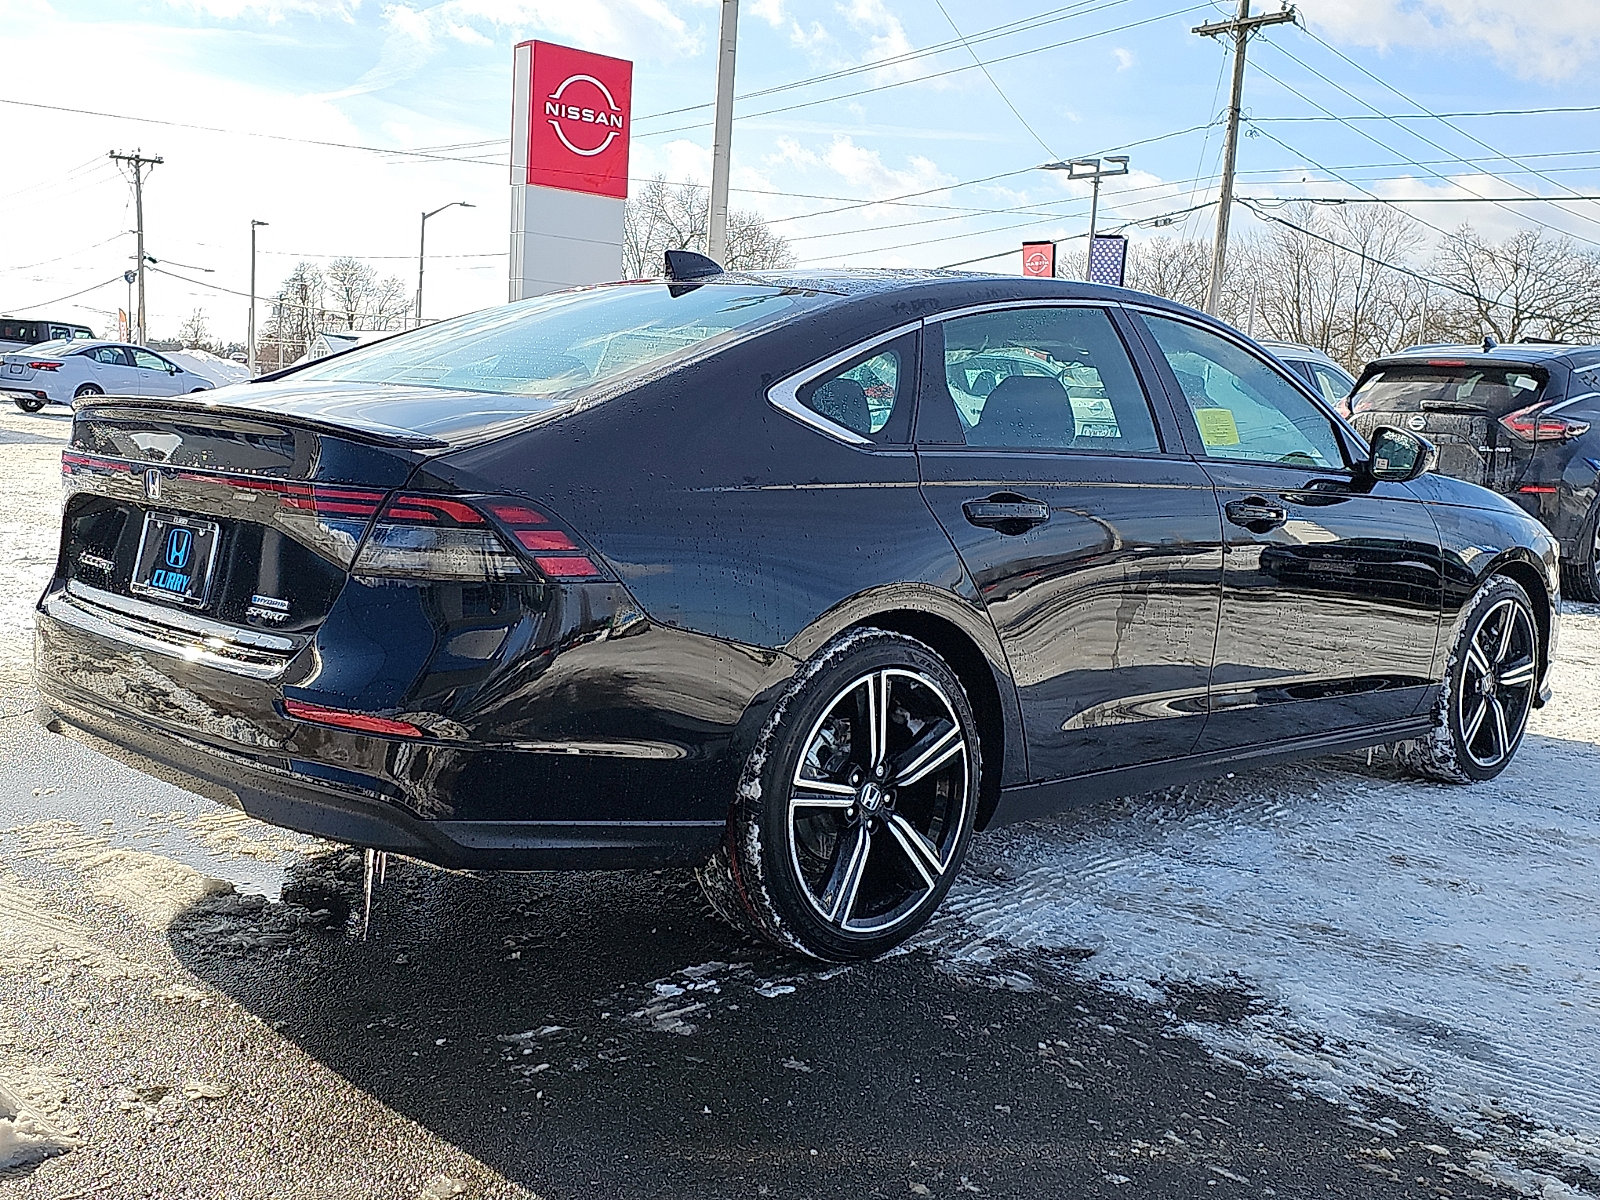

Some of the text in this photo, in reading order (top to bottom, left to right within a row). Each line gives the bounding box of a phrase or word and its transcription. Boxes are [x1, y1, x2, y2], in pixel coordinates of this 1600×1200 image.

[545, 101, 623, 128] NISSAN
[152, 569, 190, 592] CURRY
[246, 604, 290, 620] SPORT
